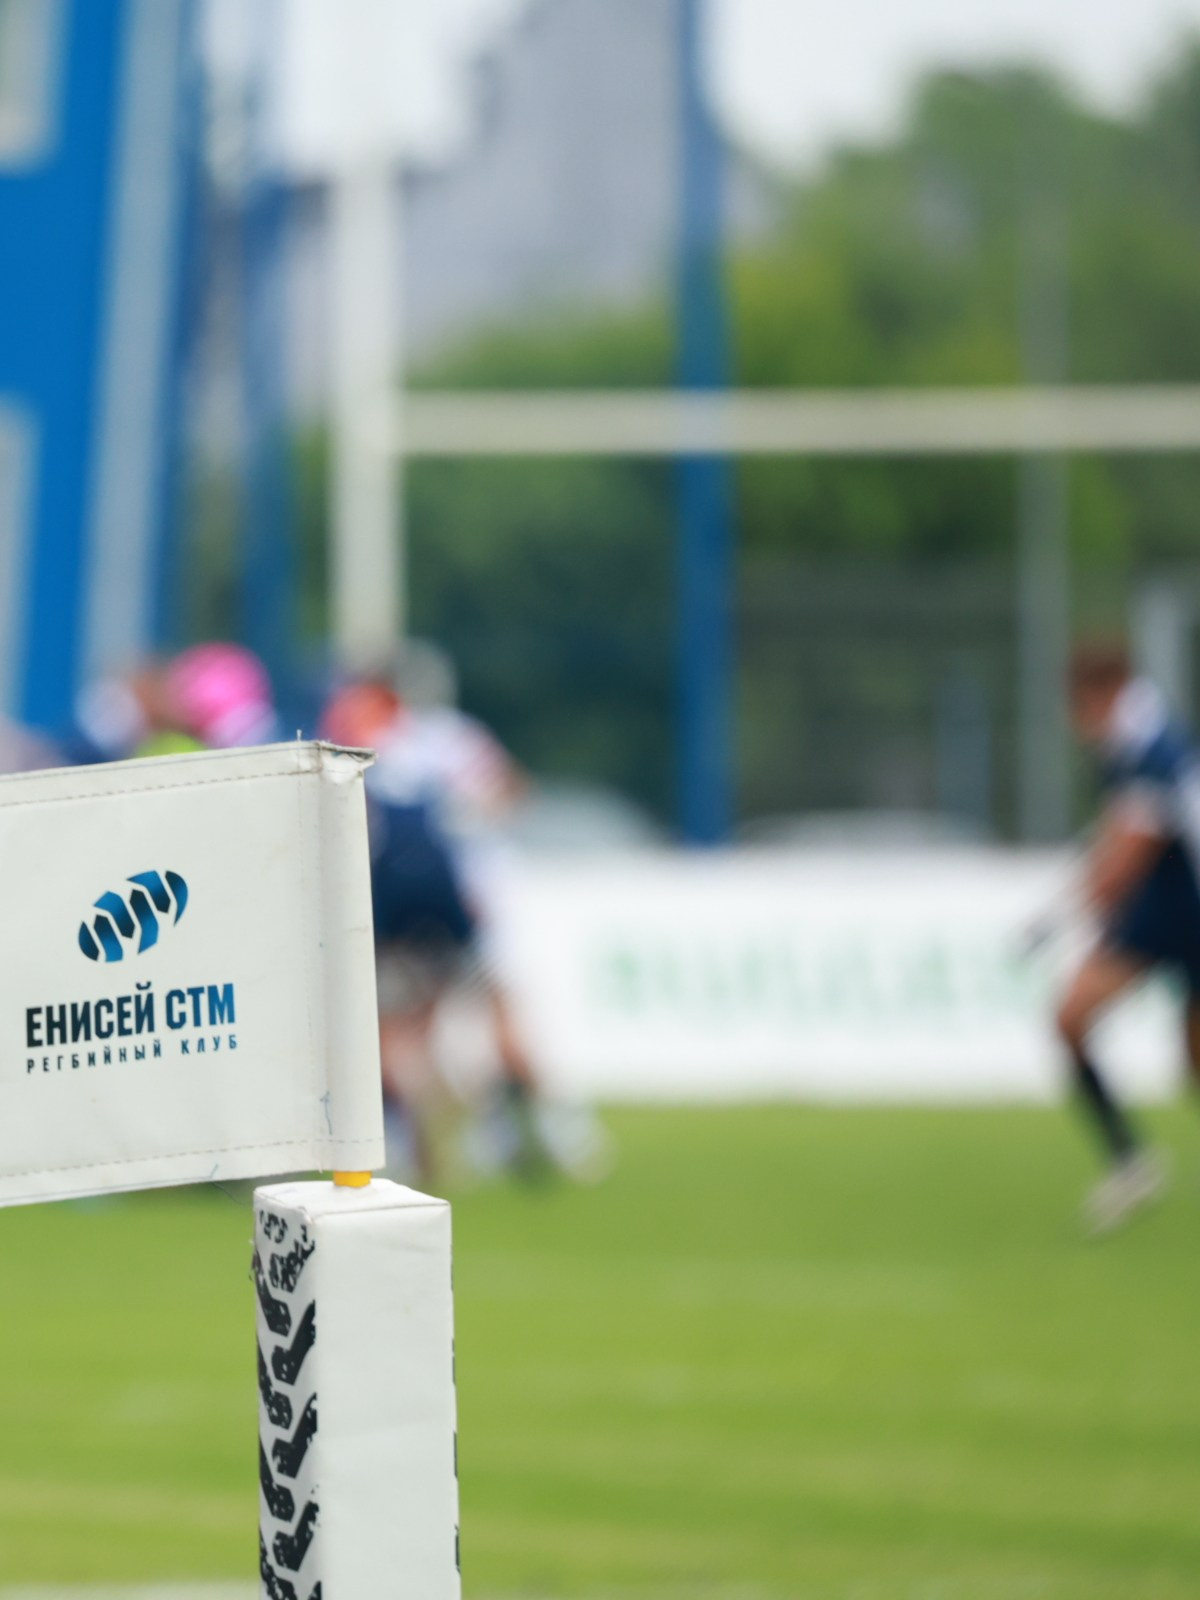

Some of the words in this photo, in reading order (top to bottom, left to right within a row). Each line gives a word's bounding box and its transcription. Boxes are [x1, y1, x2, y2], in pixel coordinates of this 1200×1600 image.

[26, 981, 155, 1048] ЕНИСЕЙ
[165, 983, 236, 1030] СТМ
[27, 1039, 162, 1074] РЕГБИЙНЫЙ
[181, 1034, 238, 1055] КЛУБ
